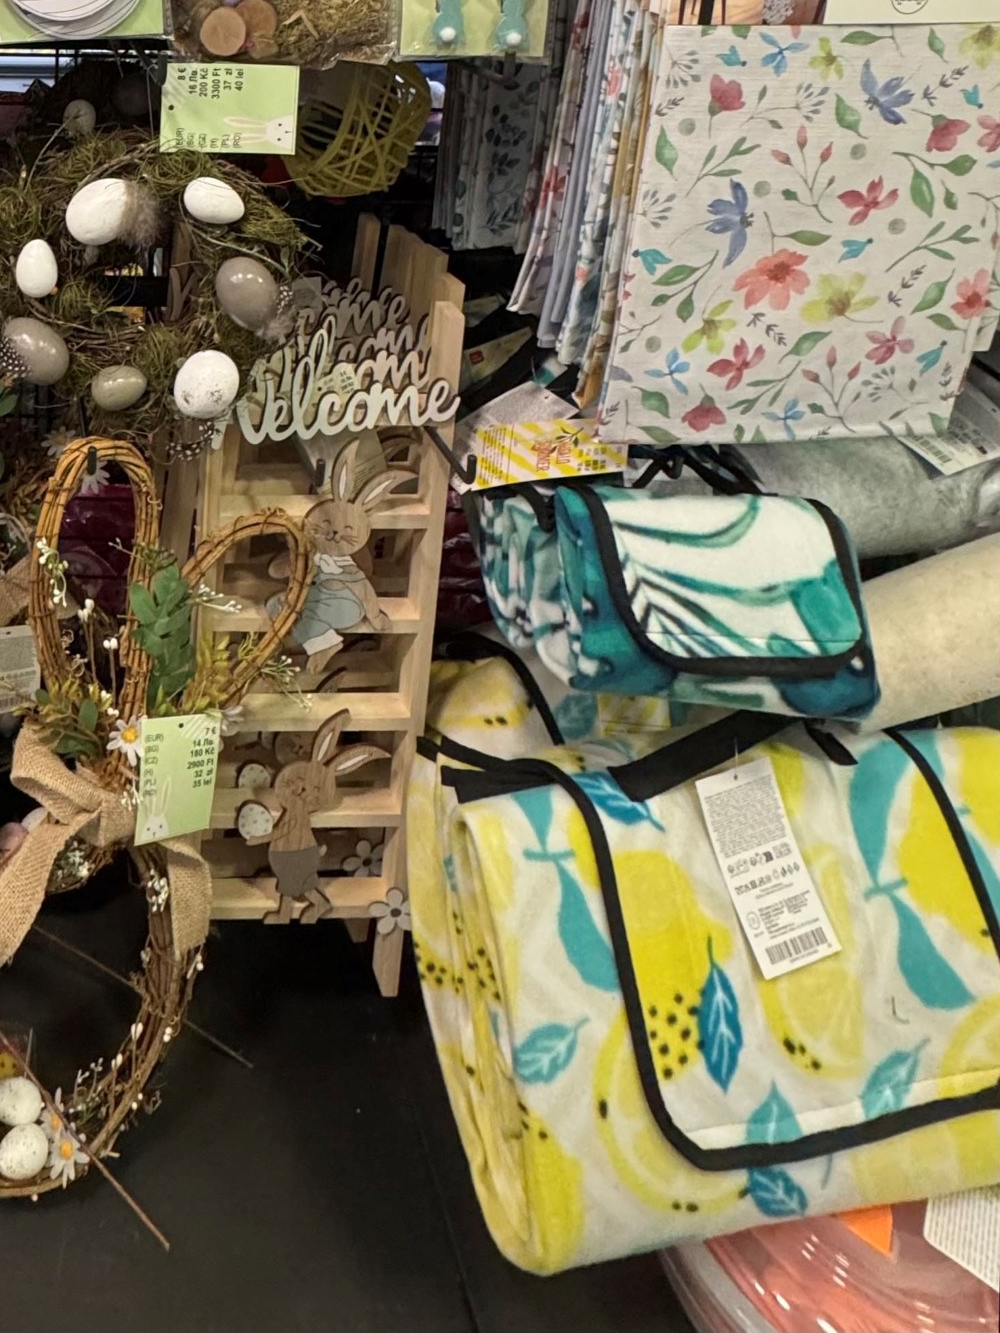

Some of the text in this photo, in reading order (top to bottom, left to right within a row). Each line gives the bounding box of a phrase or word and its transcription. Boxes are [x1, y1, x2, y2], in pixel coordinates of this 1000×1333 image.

[199, 67, 209, 80] Kč
[212, 68, 221, 77] Ft
[188, 85, 197, 95] 16
[199, 81, 208, 98] 200
[211, 78, 220, 99] 3300
[221, 68, 233, 149] (PL) 37 zł
[233, 68, 244, 149] (RO) 40 lei
[144, 726, 217, 742] (EUR) 7 €
[192, 739, 201, 747] 14
[190, 749, 203, 757] 180
[204, 746, 215, 755] Kč
[186, 760, 205, 770] 2900
[206, 758, 215, 766] Ft
[193, 770, 203, 778] 32
[206, 768, 213, 776] zł
[192, 780, 202, 789] 35
